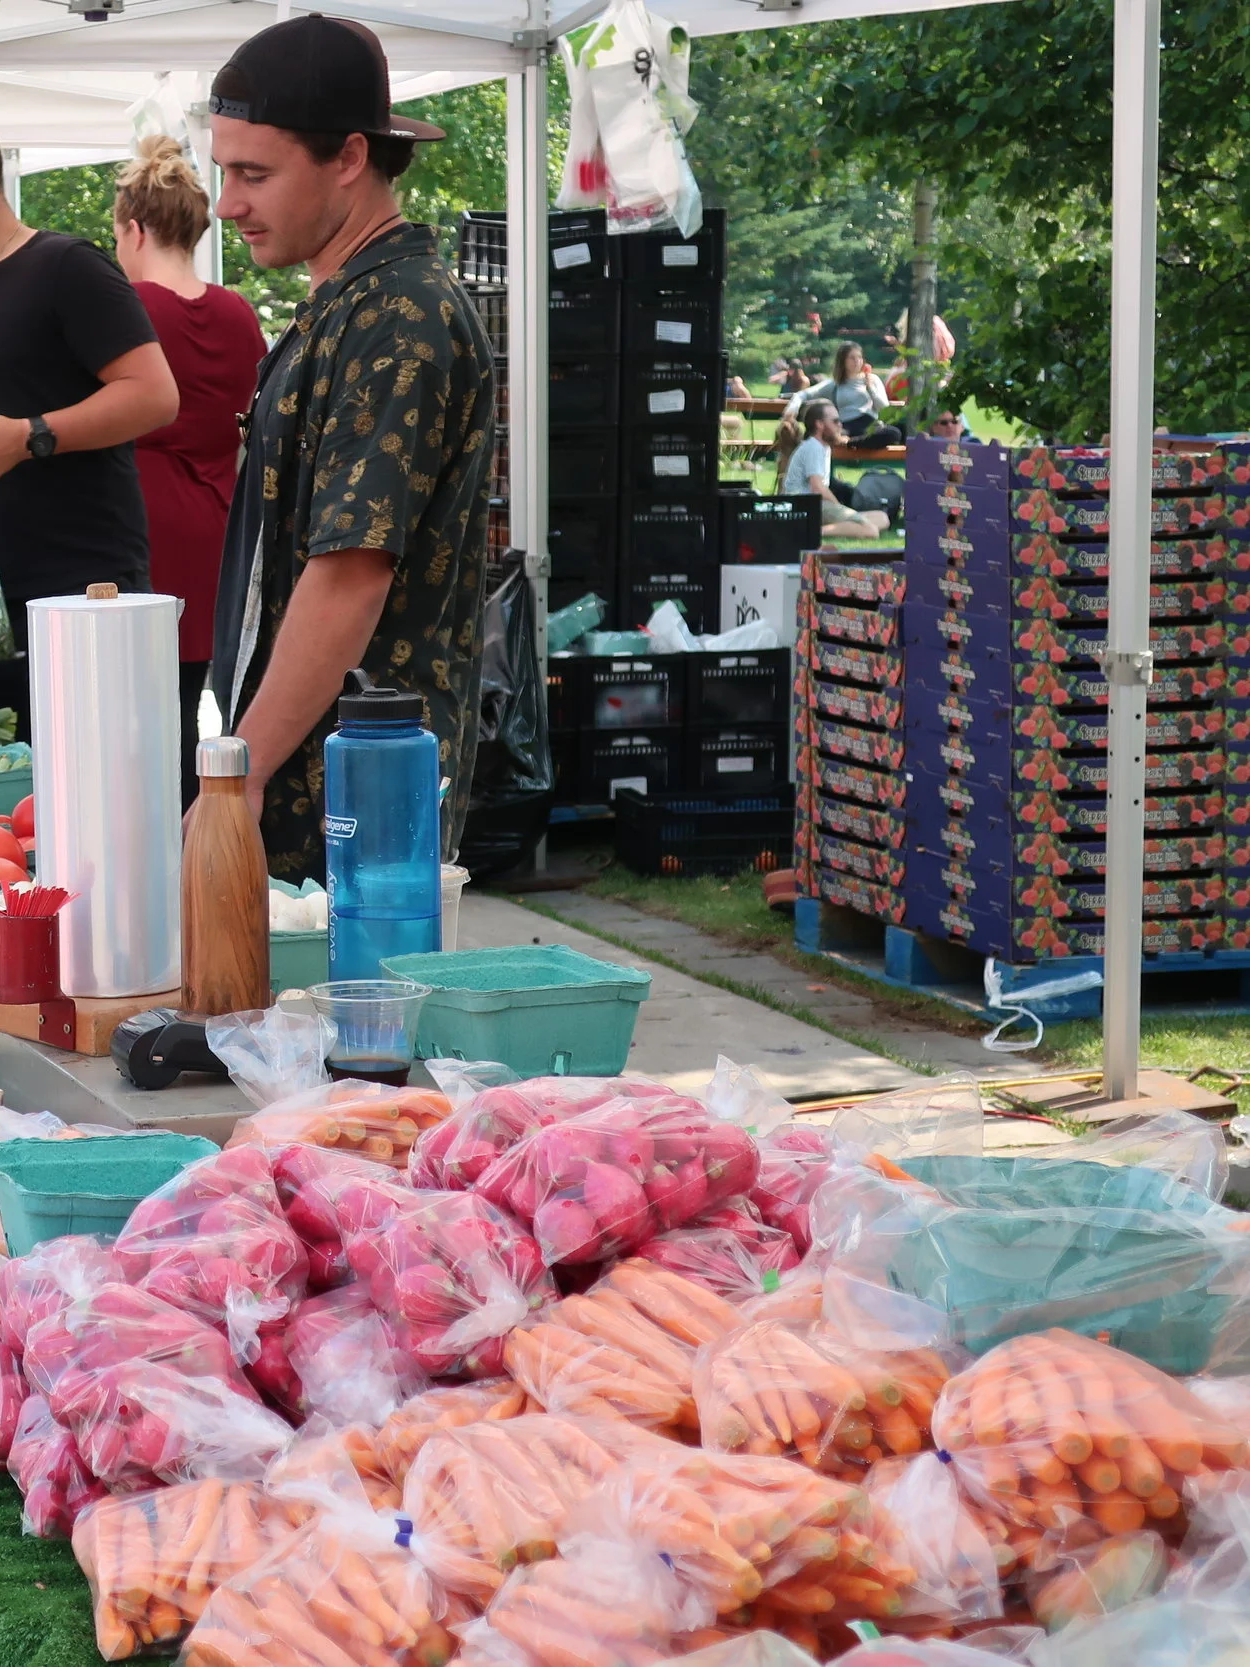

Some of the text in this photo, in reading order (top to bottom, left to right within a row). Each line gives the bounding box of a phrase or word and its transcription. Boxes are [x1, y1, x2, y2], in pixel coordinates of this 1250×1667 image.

[1078, 464, 1106, 481] BERRY
[1078, 508, 1106, 524] BERRY
[1079, 551, 1107, 567] BERRY
[1079, 594, 1108, 610] BERRY
[328, 869, 338, 961] everyday
